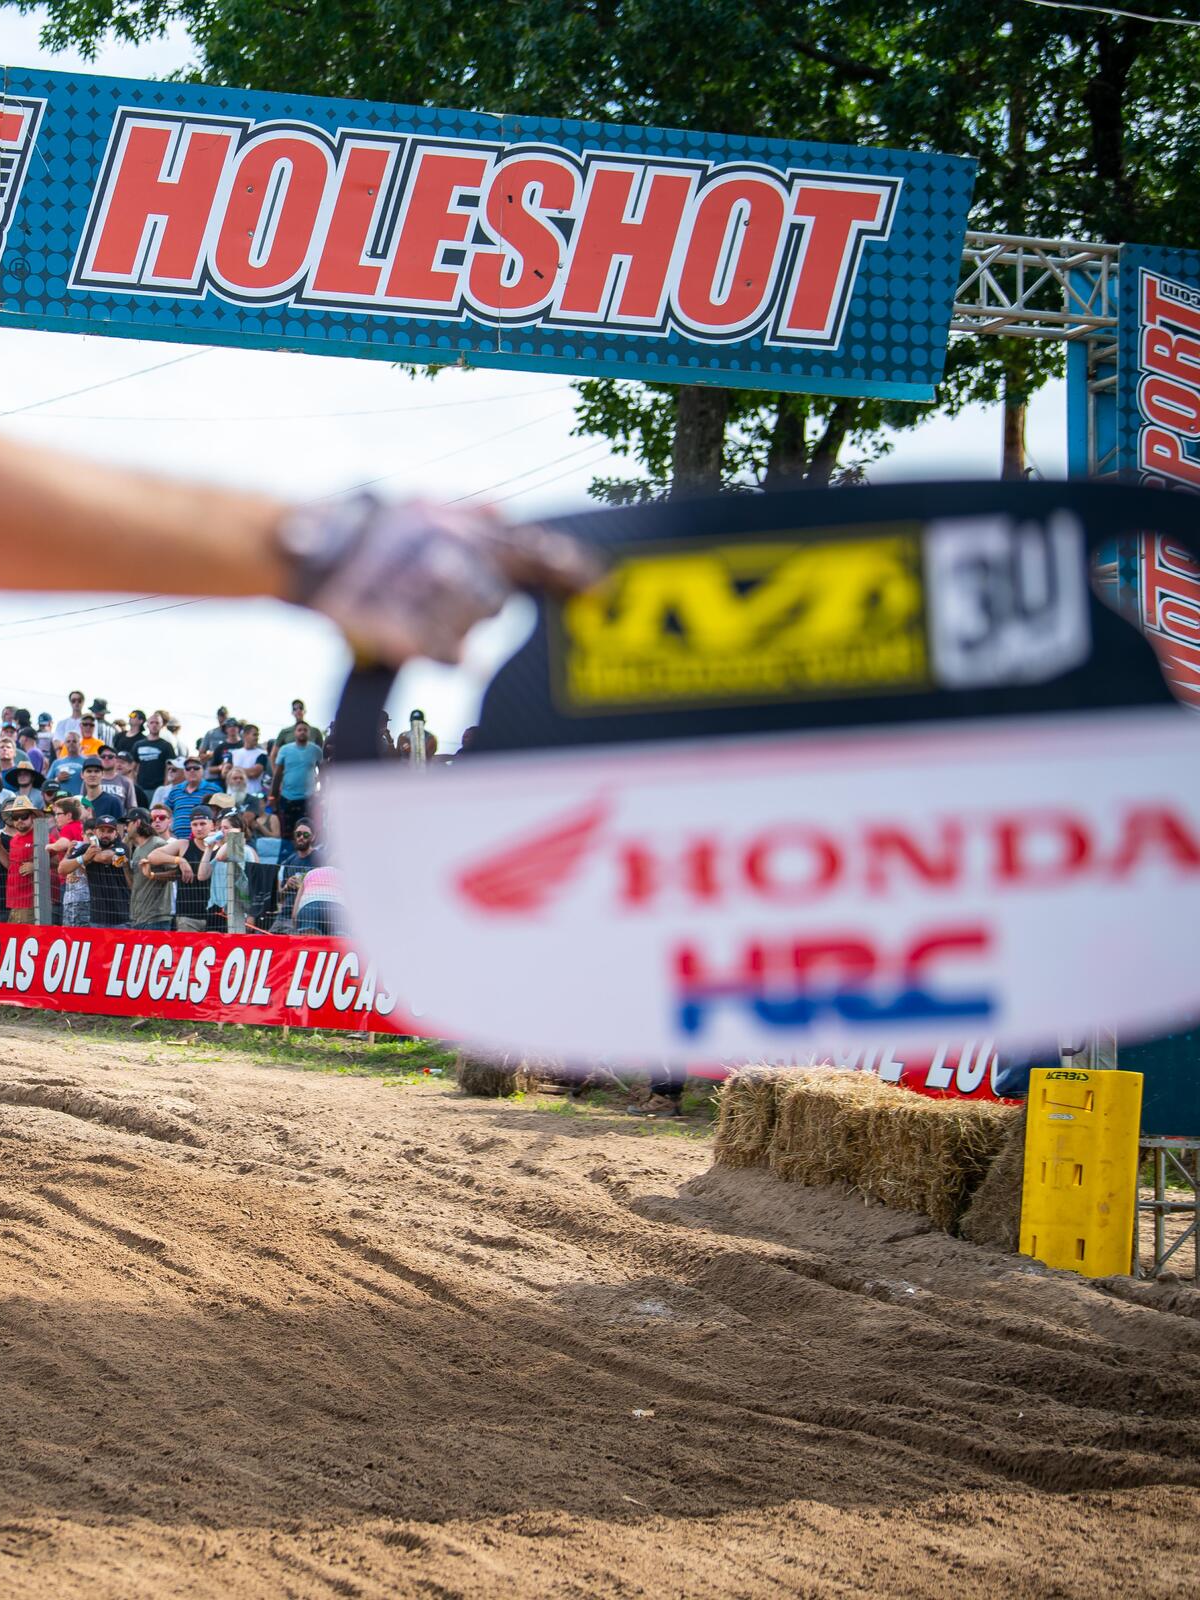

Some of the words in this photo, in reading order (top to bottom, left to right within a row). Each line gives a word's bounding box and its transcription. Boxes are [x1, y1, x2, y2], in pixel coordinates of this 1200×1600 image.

[70, 108, 903, 350] HOLESHOT
[615, 803, 1200, 911] HONDA
[43, 938, 92, 995] OIL
[105, 942, 217, 1004] LUCAS
[219, 946, 273, 1005] OIL
[668, 920, 998, 1040] HRC
